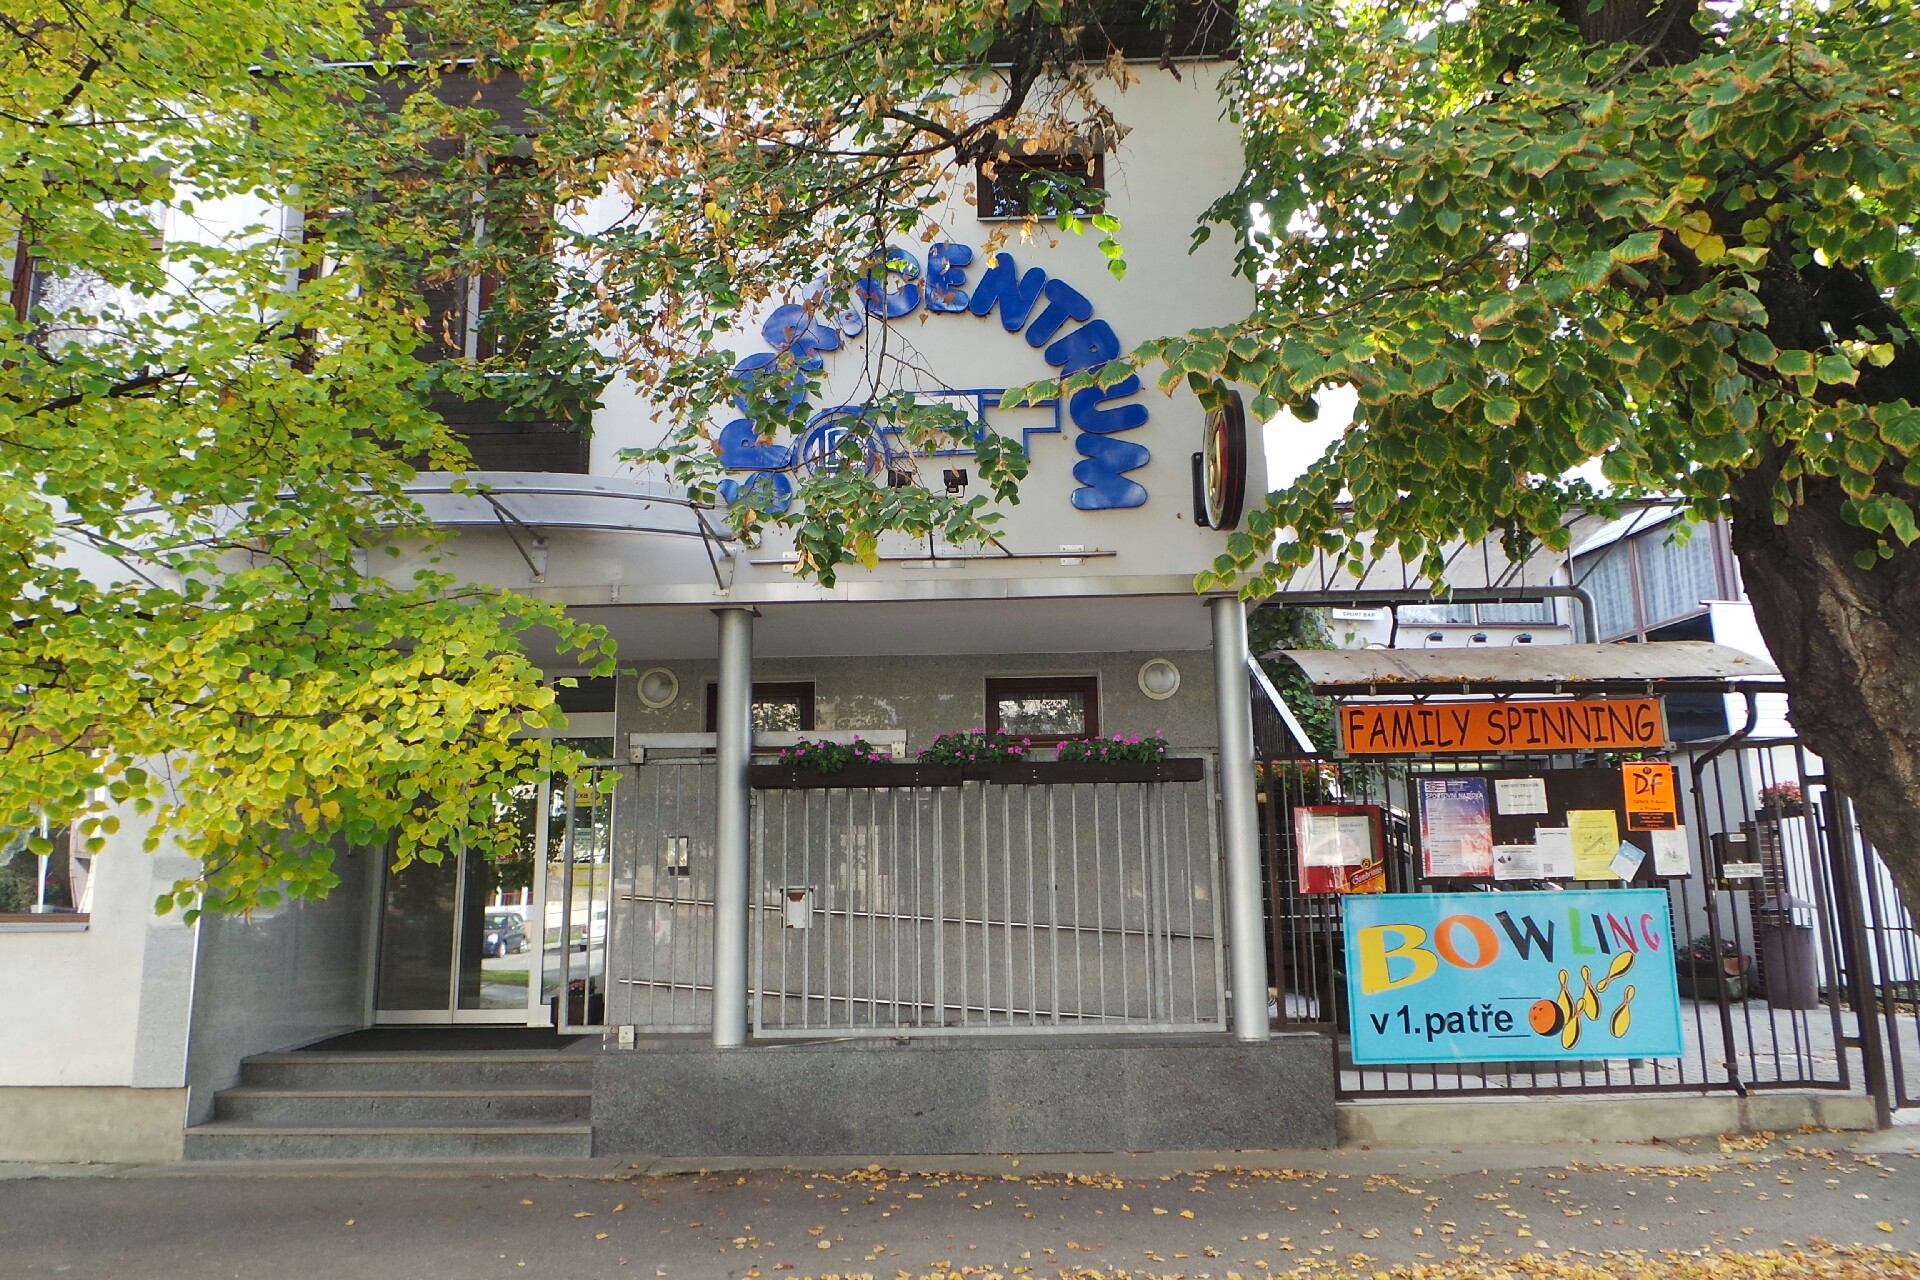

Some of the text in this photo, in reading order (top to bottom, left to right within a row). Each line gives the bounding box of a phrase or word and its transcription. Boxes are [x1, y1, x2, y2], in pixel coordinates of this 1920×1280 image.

[1349, 703, 1656, 749] FAMILY SPINNING
[1357, 906, 1661, 995] BOWLING
